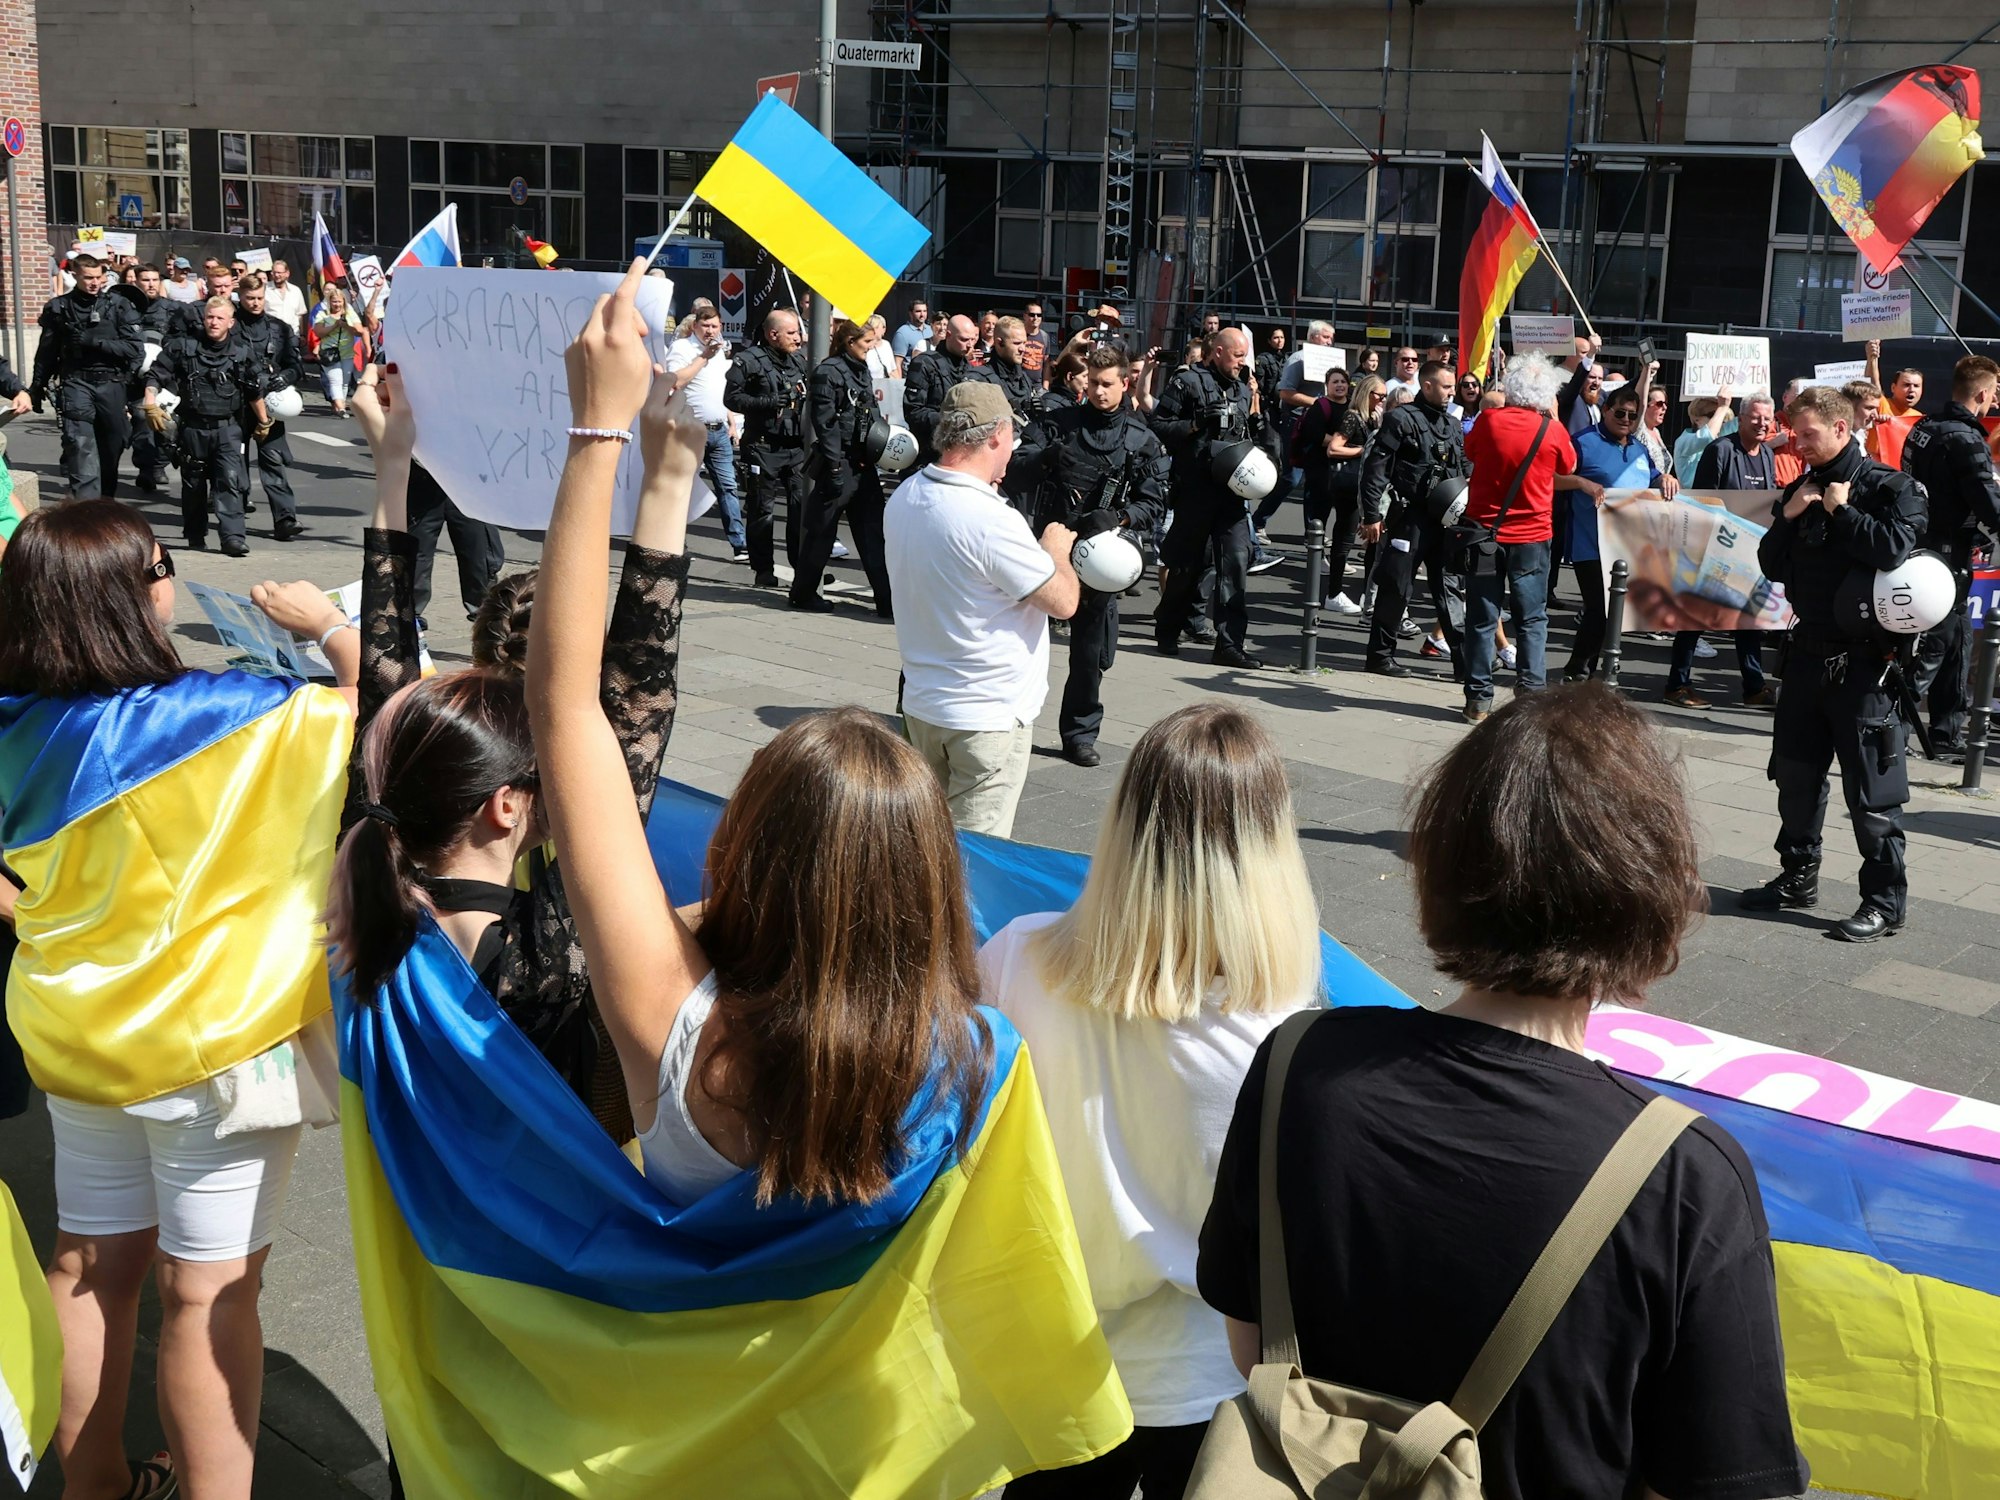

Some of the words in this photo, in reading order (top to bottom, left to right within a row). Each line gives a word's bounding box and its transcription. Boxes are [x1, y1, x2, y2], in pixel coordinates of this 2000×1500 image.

[837, 43, 915, 64] Quatermarkt
[1857, 295, 1880, 303] wollen
[1882, 293, 1910, 301] Frieden
[1849, 307, 1871, 315] KEINE
[1873, 305, 1901, 314] Waffen
[722, 322, 745, 333] TEUPE
[1687, 342, 1760, 360] DISKRIMINIERUNG
[1688, 366, 1704, 382] IST
[1716, 525, 1737, 549] 20
[1877, 597, 1891, 625] NRW
[1891, 582, 1919, 630] 10-1-1
